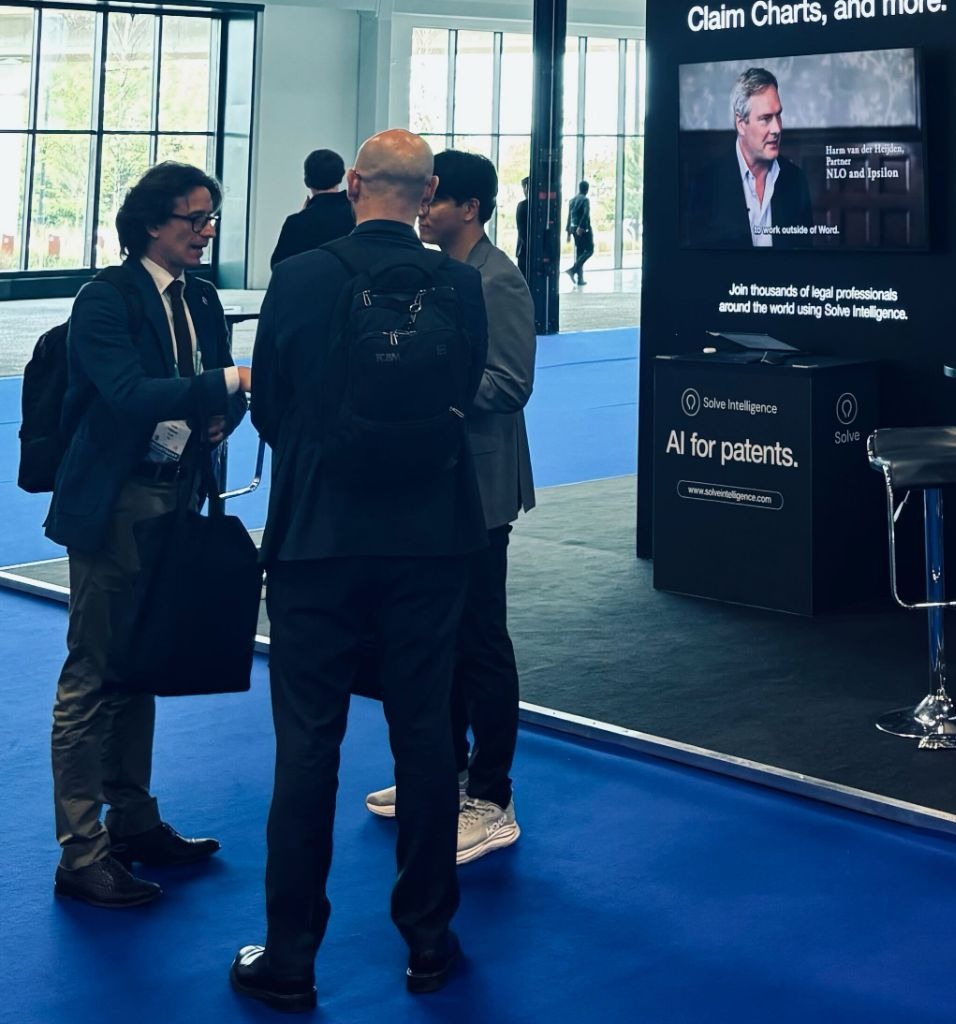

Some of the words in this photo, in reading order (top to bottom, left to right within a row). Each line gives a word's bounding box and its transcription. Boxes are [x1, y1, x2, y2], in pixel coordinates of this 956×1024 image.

[687, 4, 745, 32] Claim
[825, 145, 846, 155] Harm
[861, 144, 873, 154] der
[826, 157, 852, 166] Partner
[826, 168, 847, 179] NLO
[849, 168, 865, 178] and
[867, 167, 899, 181] Ipsilon
[763, 225, 780, 234] work
[782, 225, 808, 234] outside
[809, 225, 817, 234] of
[818, 225, 840, 234] Word.
[729, 283, 748, 296] Join
[750, 284, 798, 297] thousands
[800, 285, 810, 297] of
[812, 286, 834, 301] legal
[836, 286, 898, 302] professionals
[719, 301, 751, 313] around
[753, 301, 768, 314] the
[770, 302, 795, 315] world
[797, 303, 822, 318] using
[825, 303, 850, 317] Solve
[852, 305, 908, 322] Intelligence.
[703, 396, 726, 410] Solve
[727, 399, 778, 415] Intelligence
[834, 430, 861, 444] Solve
[666, 429, 685, 455] AI
[690, 432, 716, 458] for
[721, 439, 799, 468] patents.
[688, 485, 772, 504] www.solveintelligence.com
